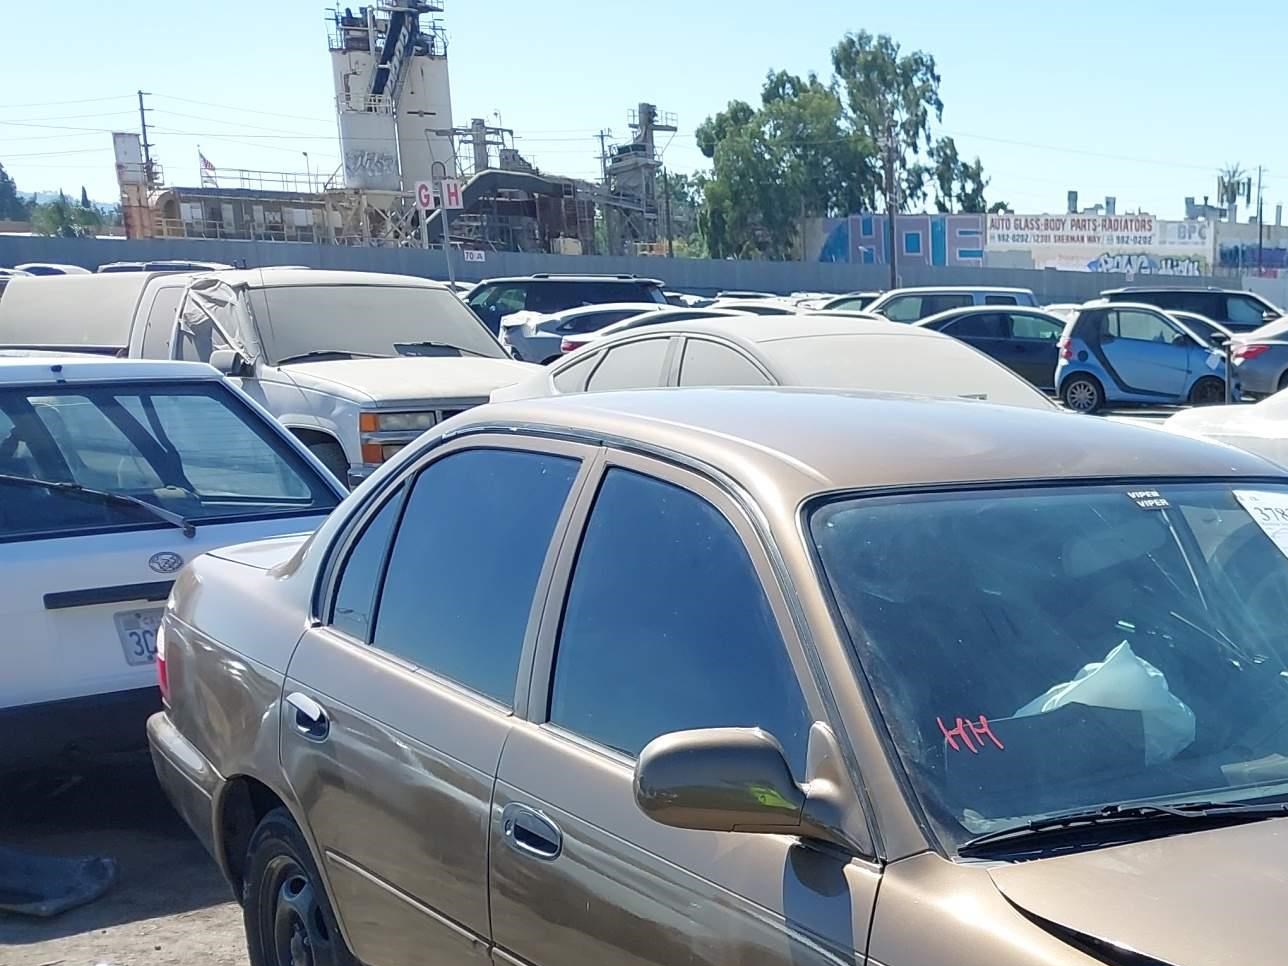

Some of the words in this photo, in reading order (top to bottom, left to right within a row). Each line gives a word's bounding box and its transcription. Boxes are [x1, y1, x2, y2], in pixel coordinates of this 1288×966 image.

[418, 184, 430, 208] G
[446, 183, 460, 206] H
[990, 218, 1010, 231] AUTO
[1177, 223, 1207, 240] BPC
[1054, 234, 1084, 243] SHERMAN
[1127, 490, 1160, 499] VIPER
[1136, 499, 1169, 507] VIPER
